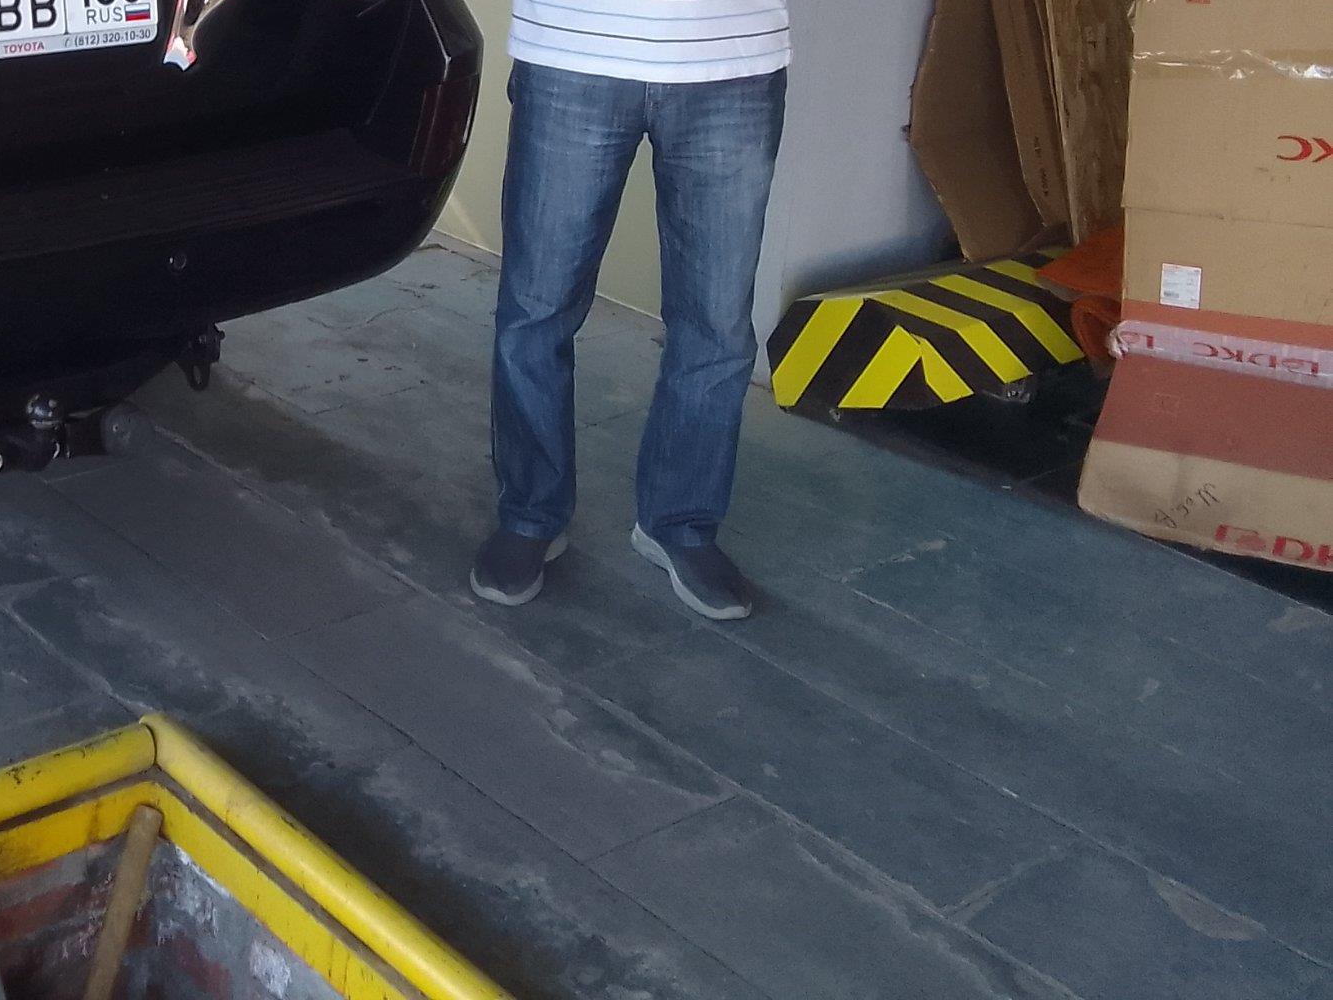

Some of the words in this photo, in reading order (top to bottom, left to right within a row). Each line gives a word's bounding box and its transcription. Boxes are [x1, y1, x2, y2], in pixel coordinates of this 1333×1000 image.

[86, 7, 123, 25] RUS
[3, 41, 45, 54] TOYOTA
[74, 33, 100, 47] (812)
